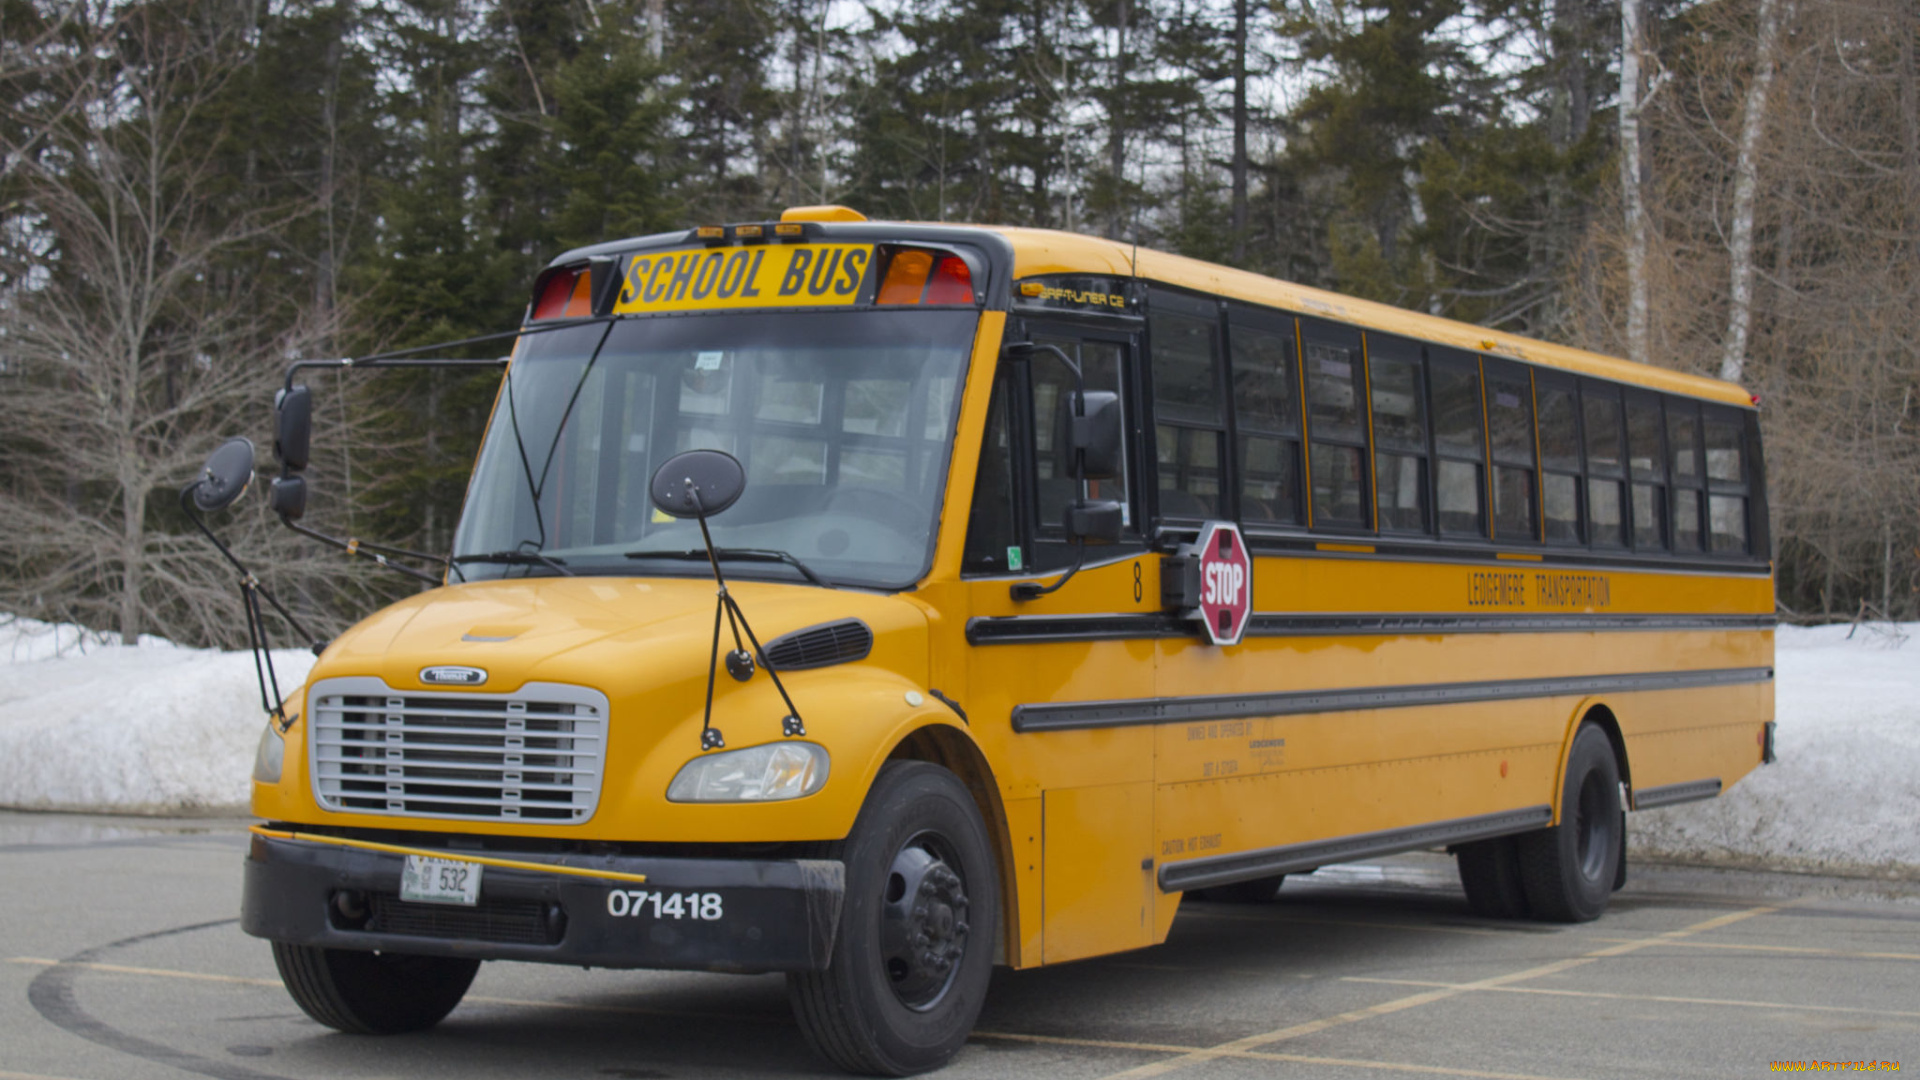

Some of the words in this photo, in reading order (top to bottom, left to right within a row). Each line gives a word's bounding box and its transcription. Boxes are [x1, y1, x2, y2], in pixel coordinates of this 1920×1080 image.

[620, 249, 767, 305] SCHOOL
[778, 247, 868, 297] BUS
[1133, 561, 1142, 603] 8
[1205, 561, 1243, 606] STOP
[1467, 572, 1525, 606] LEDGEMERE
[1535, 573, 1611, 607] TRANSPORTATION
[439, 867, 468, 892] 532
[607, 889, 723, 920] 071418
